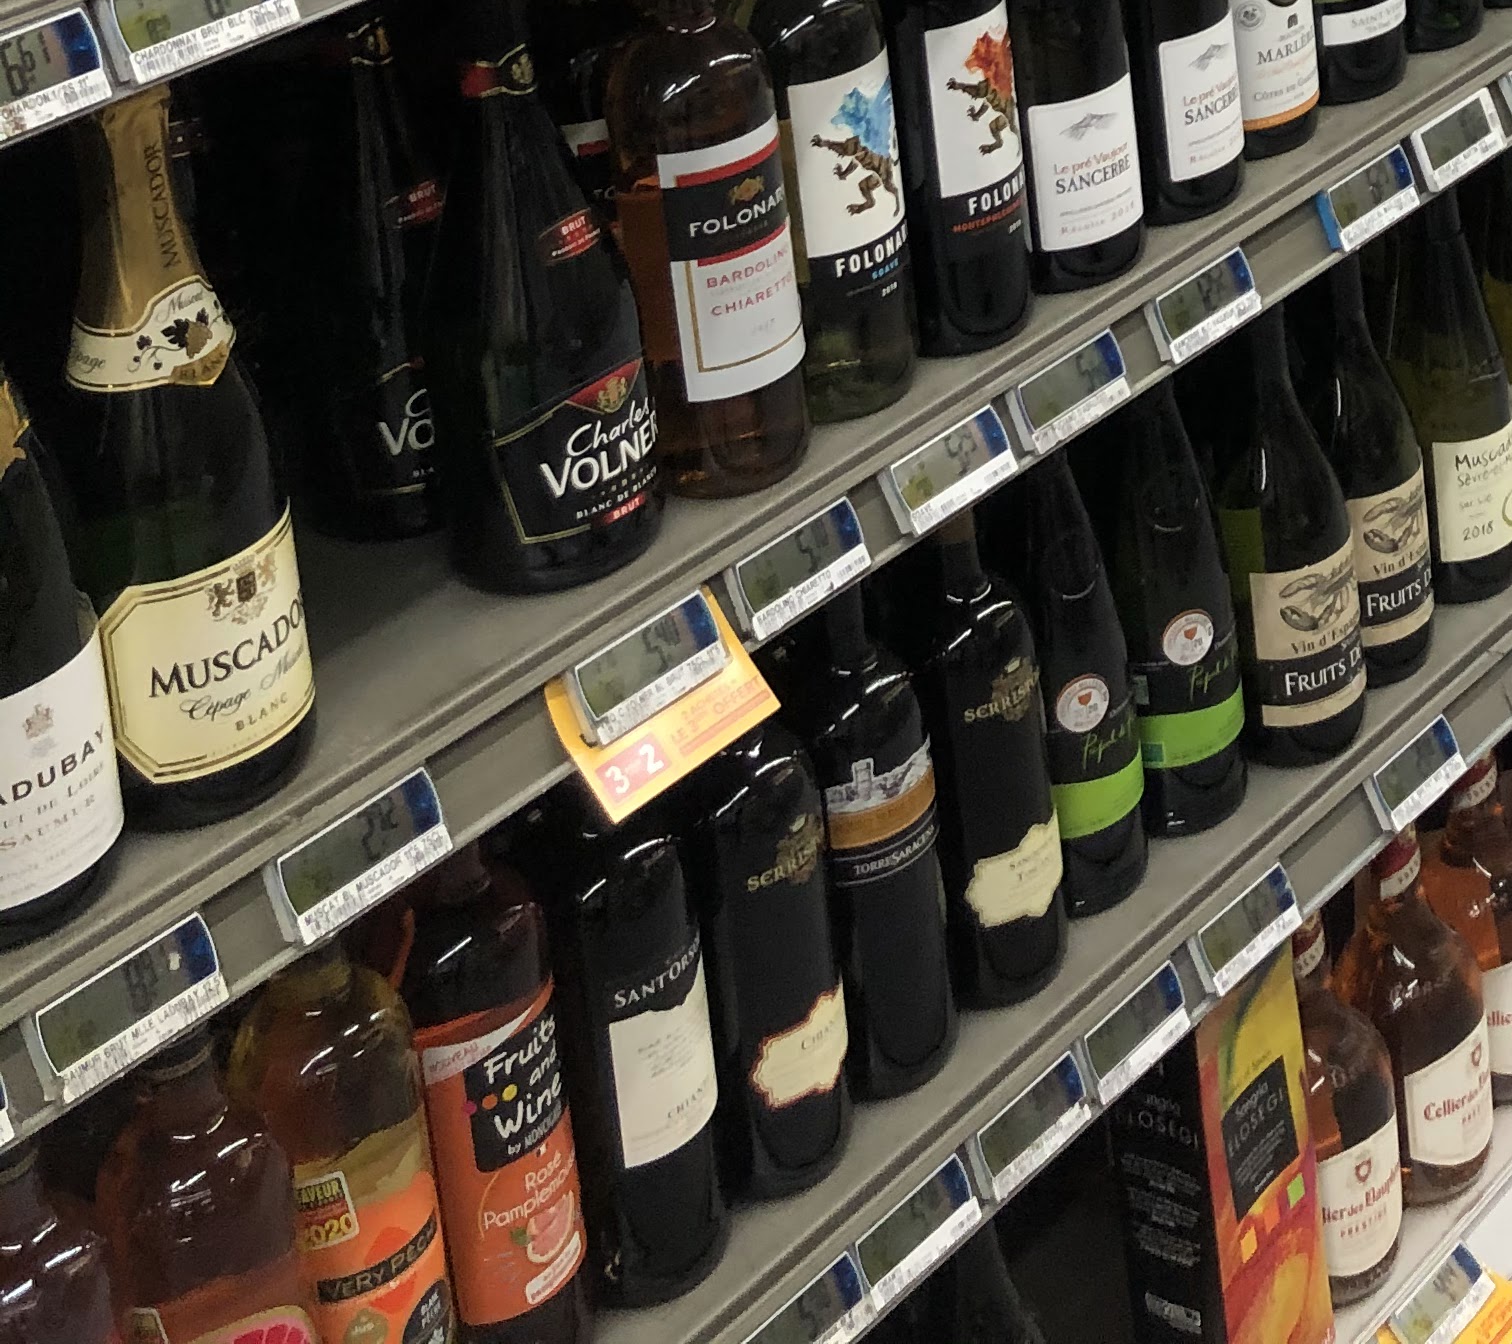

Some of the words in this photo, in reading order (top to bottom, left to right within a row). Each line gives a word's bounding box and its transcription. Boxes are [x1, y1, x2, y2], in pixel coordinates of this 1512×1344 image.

[134, 29, 198, 65] CHARDONNAY
[201, 21, 227, 40] BRUT
[1053, 161, 1069, 178] Le
[1055, 154, 1132, 197] SANCERRE
[560, 213, 588, 236] BRUT
[870, 258, 899, 281] SOAVE
[566, 396, 650, 459] Charles
[575, 497, 613, 522] BLANC
[616, 489, 631, 505] DE
[612, 497, 643, 520] BRUT
[1462, 519, 1494, 542] 2018
[1373, 559, 1393, 577] Vin
[1366, 578, 1422, 618] FRUITS
[1291, 637, 1316, 656] Vin
[1284, 656, 1347, 697] FRUITS
[235, 690, 290, 732] BLANC
[482, 1014, 556, 1085] Fruits
[529, 1048, 557, 1090] and
[492, 1071, 563, 1139] Wine
[523, 1152, 563, 1191] Rosé
